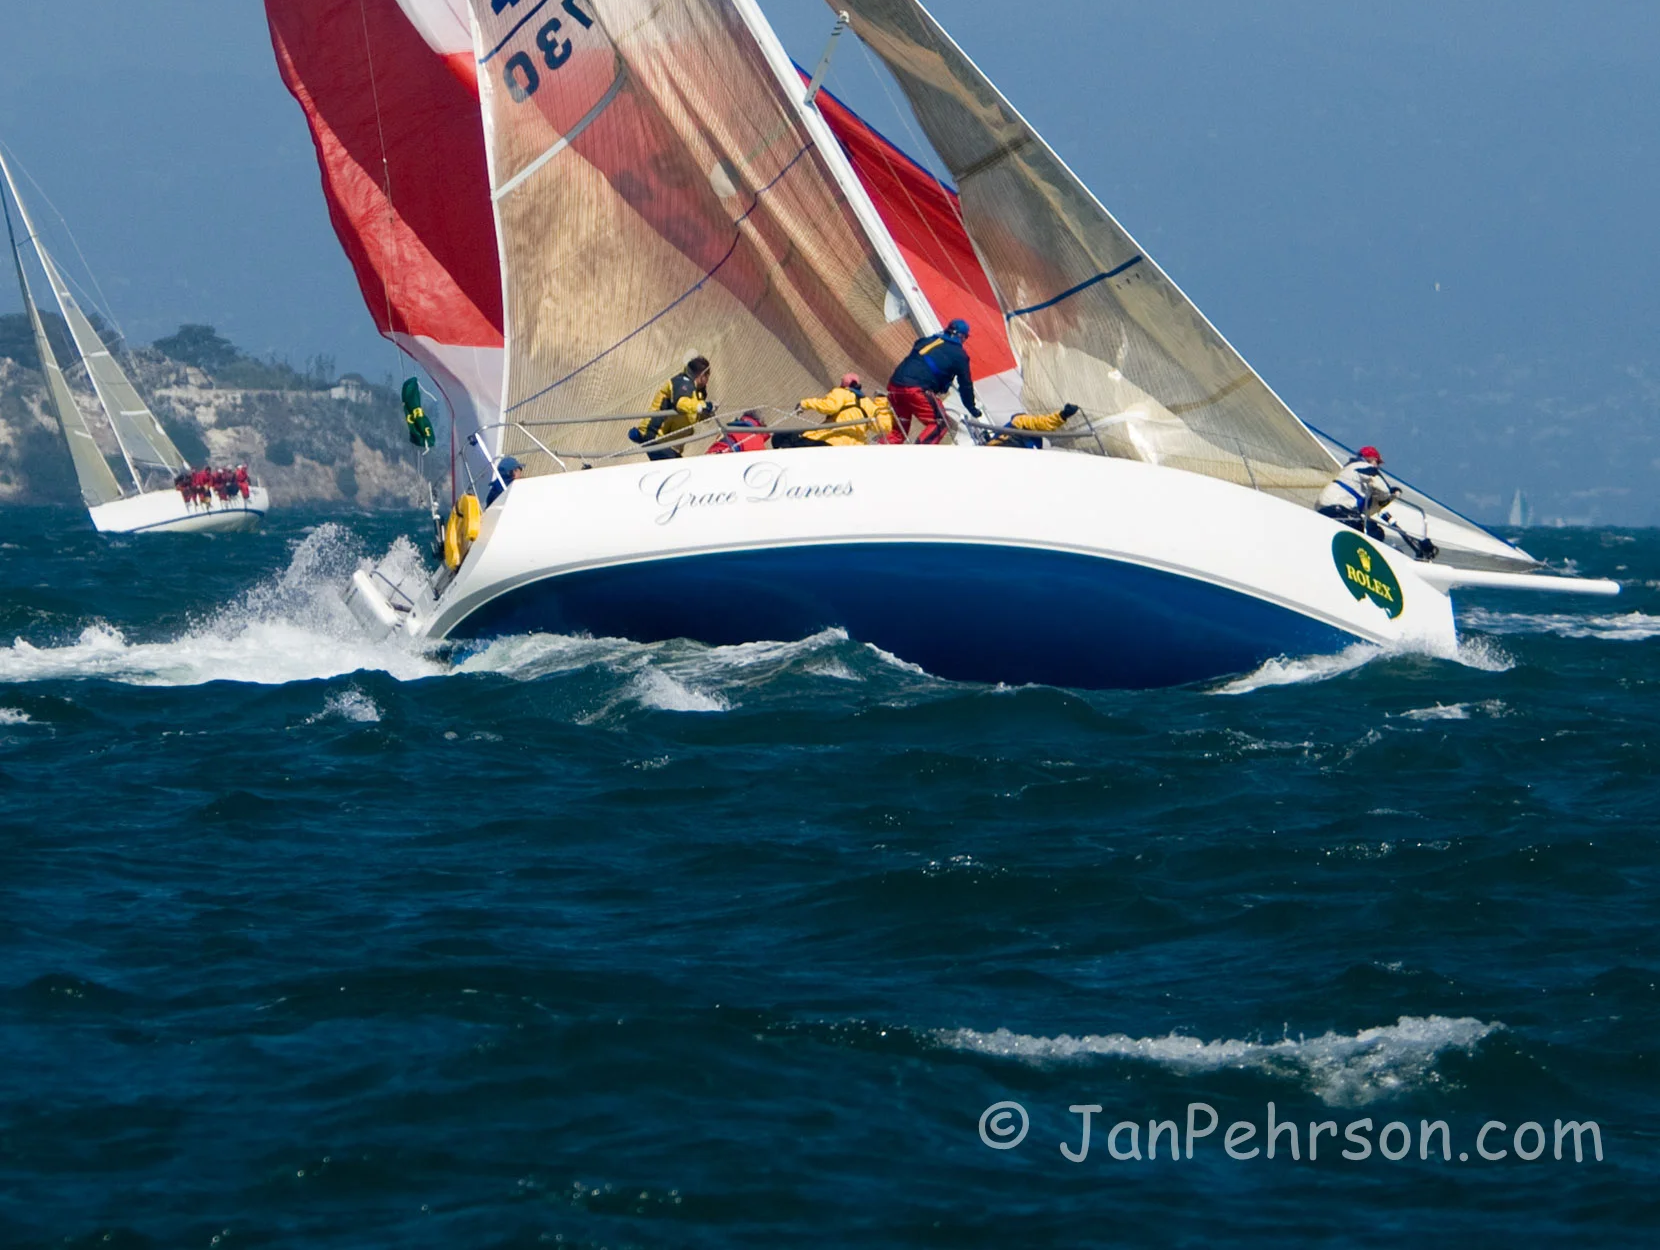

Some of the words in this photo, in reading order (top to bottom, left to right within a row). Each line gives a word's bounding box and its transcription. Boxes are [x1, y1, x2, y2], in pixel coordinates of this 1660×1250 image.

[638, 468, 737, 526] Grace
[743, 461, 854, 502] Dances
[1346, 564, 1394, 602] ROLEX
